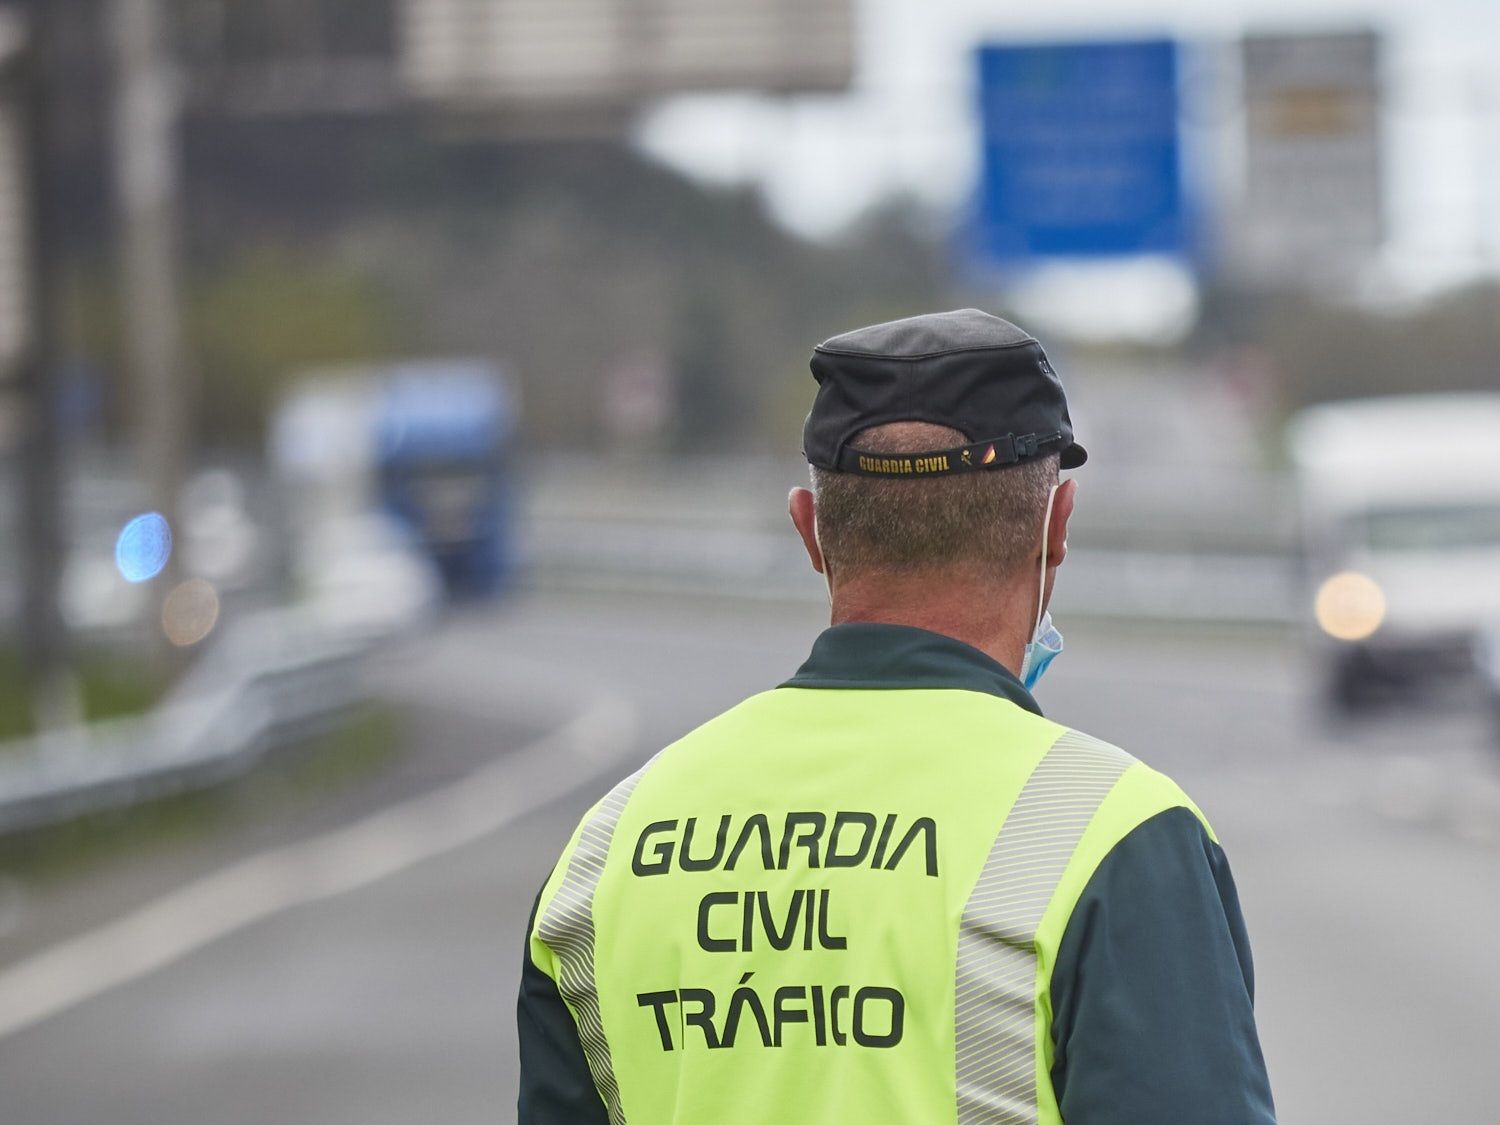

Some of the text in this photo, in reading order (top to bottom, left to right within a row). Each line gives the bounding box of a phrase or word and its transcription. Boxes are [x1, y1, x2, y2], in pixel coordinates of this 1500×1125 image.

[859, 456, 949, 473] GUARDIA CIVIL
[631, 811, 939, 877] GUARDIA
[697, 889, 848, 953] CIVIL
[636, 972, 905, 1052] TRÁFICO
